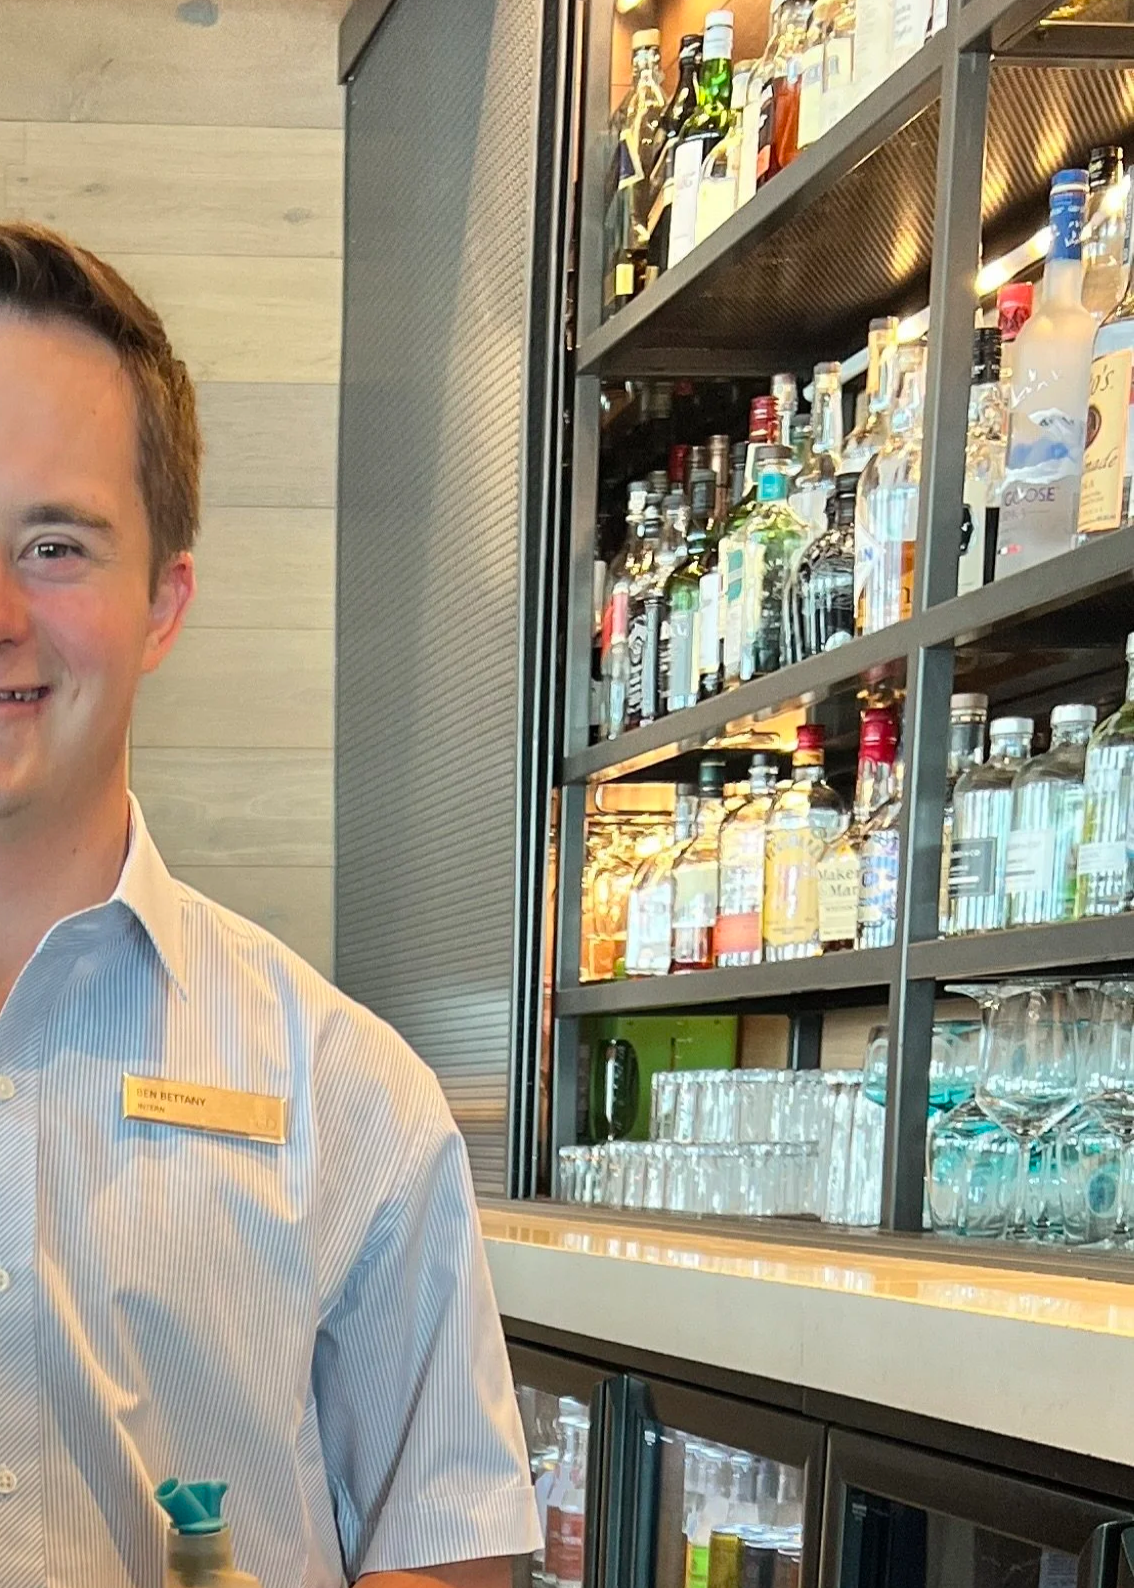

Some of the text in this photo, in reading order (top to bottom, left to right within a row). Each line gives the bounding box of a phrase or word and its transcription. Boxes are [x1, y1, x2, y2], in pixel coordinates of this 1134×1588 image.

[1004, 487, 1056, 507] GOOSE
[136, 1088, 206, 1107] BEN BETTANY
